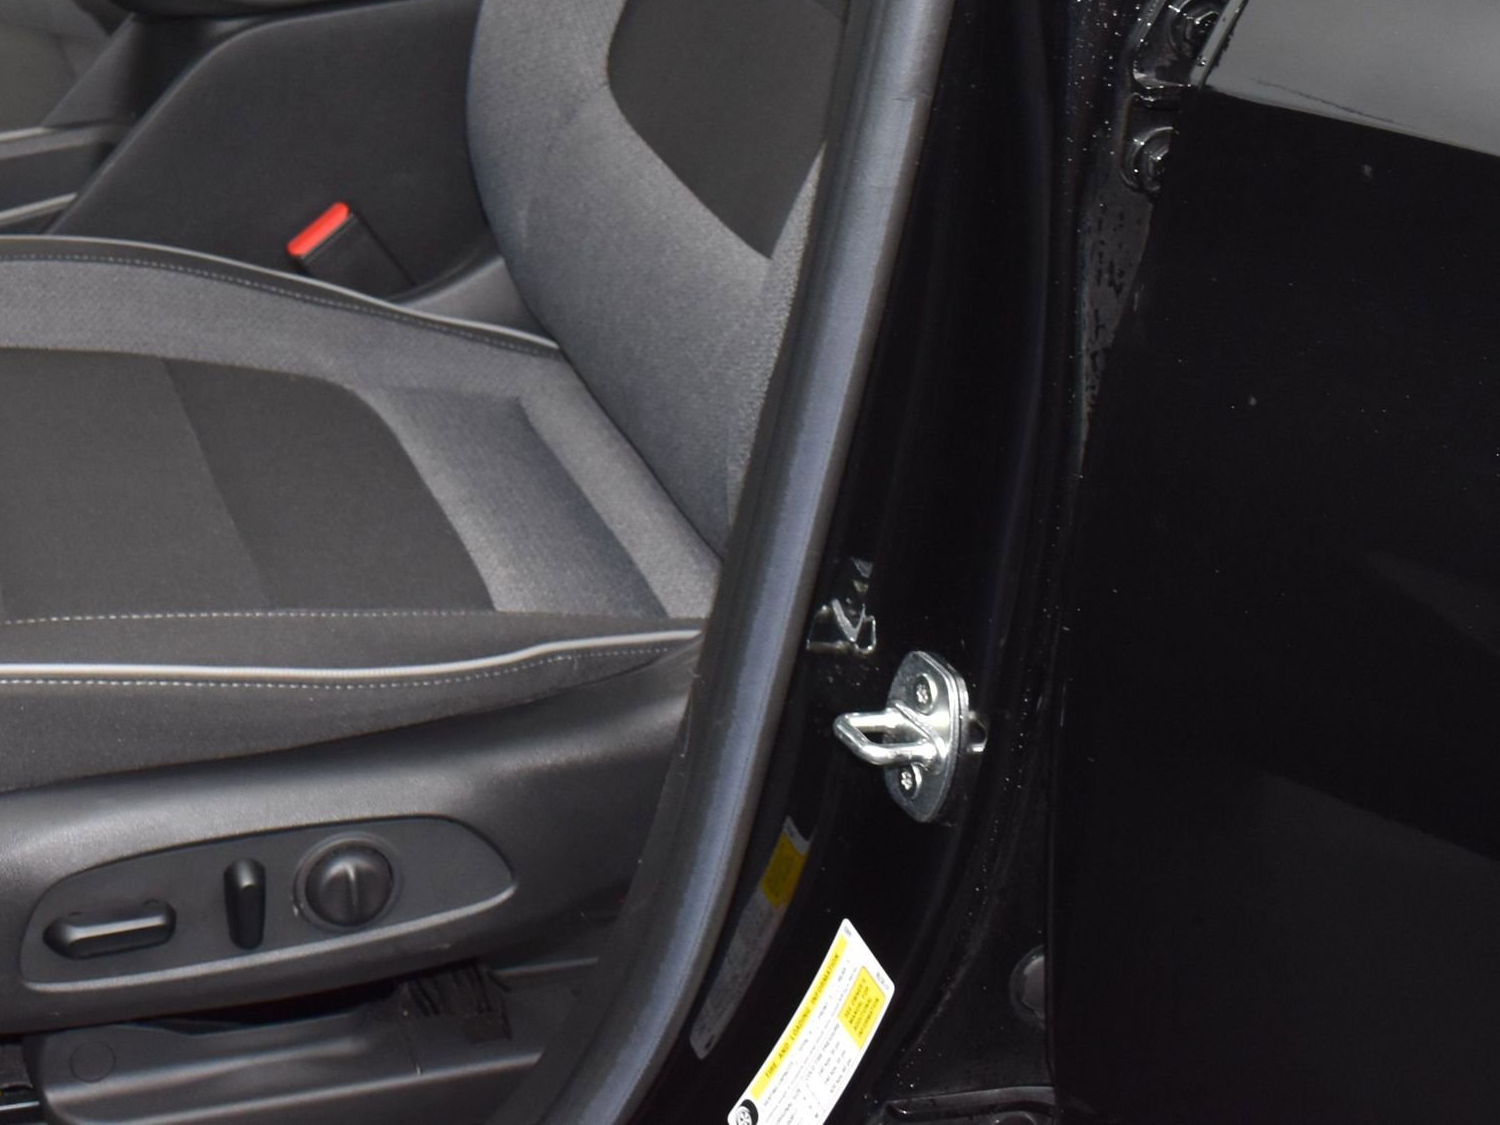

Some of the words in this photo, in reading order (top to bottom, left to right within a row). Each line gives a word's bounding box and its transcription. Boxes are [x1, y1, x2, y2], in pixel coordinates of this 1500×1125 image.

[778, 1041, 790, 1060] AND
[790, 1007, 811, 1041] LOADING
[811, 953, 840, 1006] INFORMATION
